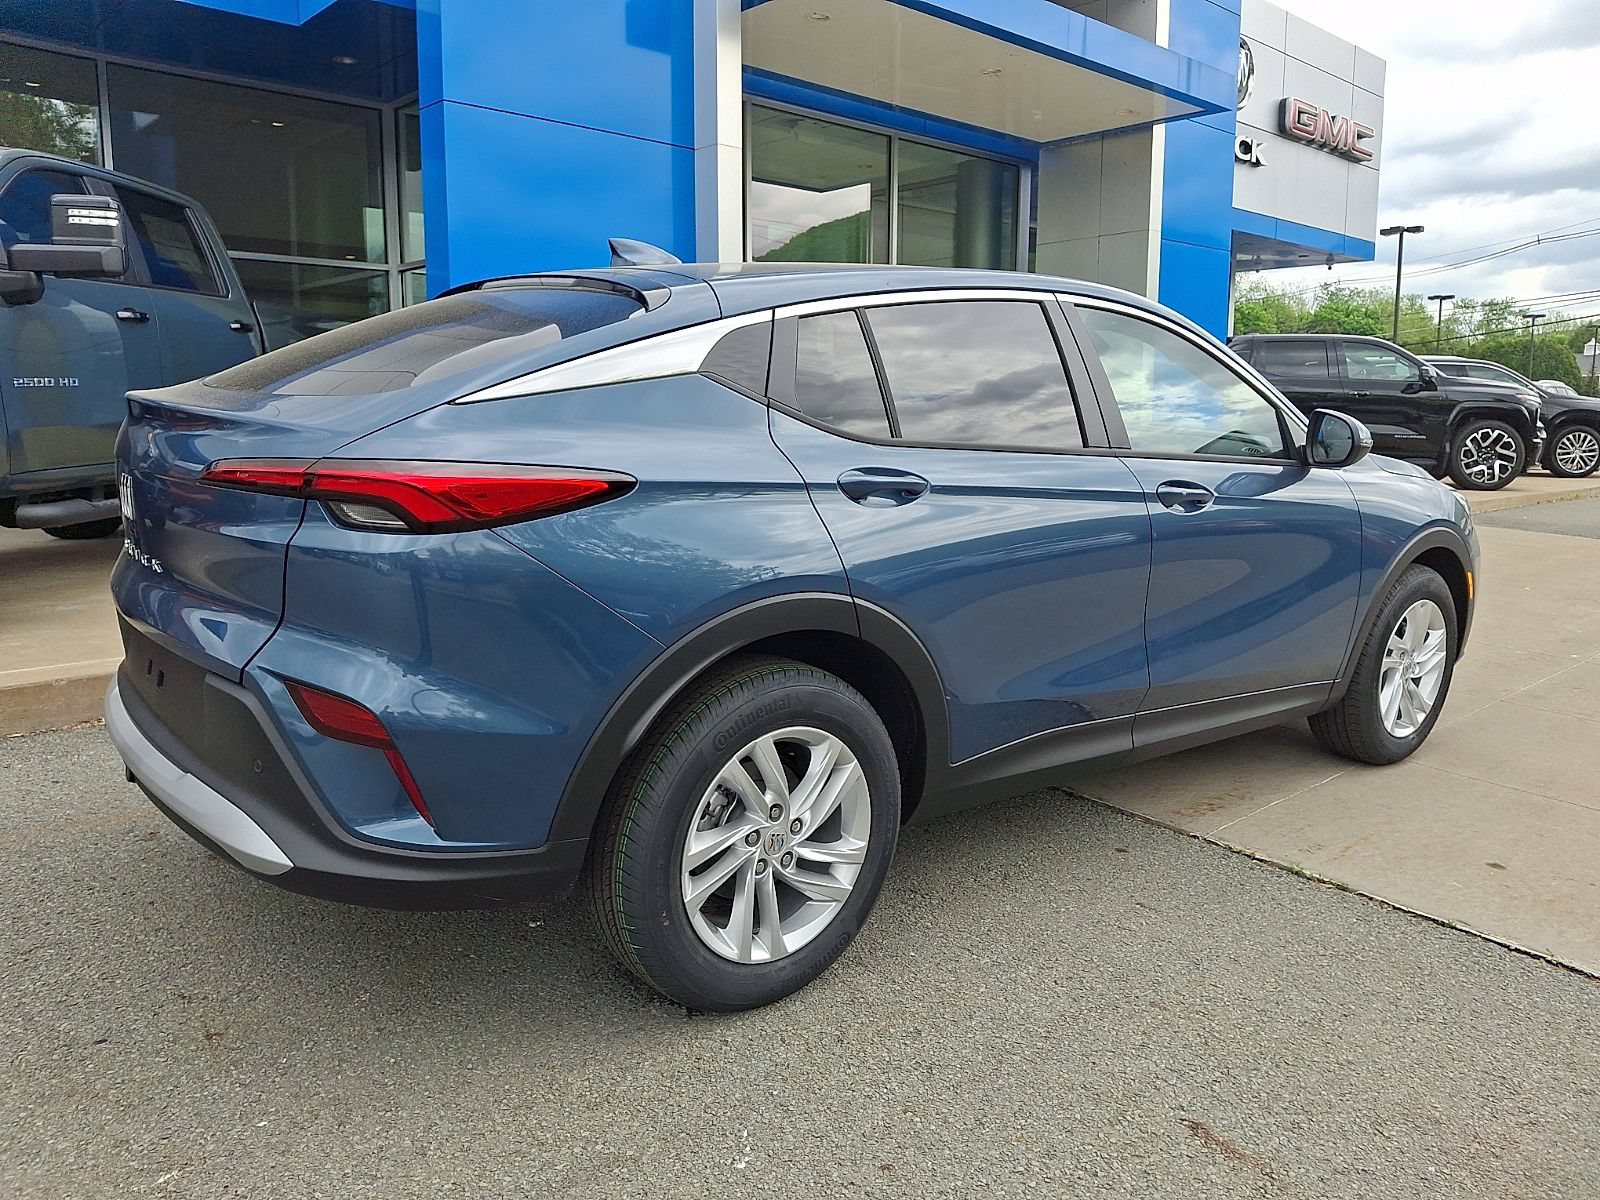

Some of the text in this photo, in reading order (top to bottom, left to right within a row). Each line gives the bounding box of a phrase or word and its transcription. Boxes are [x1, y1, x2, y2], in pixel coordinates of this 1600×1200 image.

[1234, 135, 1268, 167] CK
[1281, 97, 1375, 162] GMC
[13, 377, 79, 388] 2500 HD
[713, 693, 792, 753] Continental
